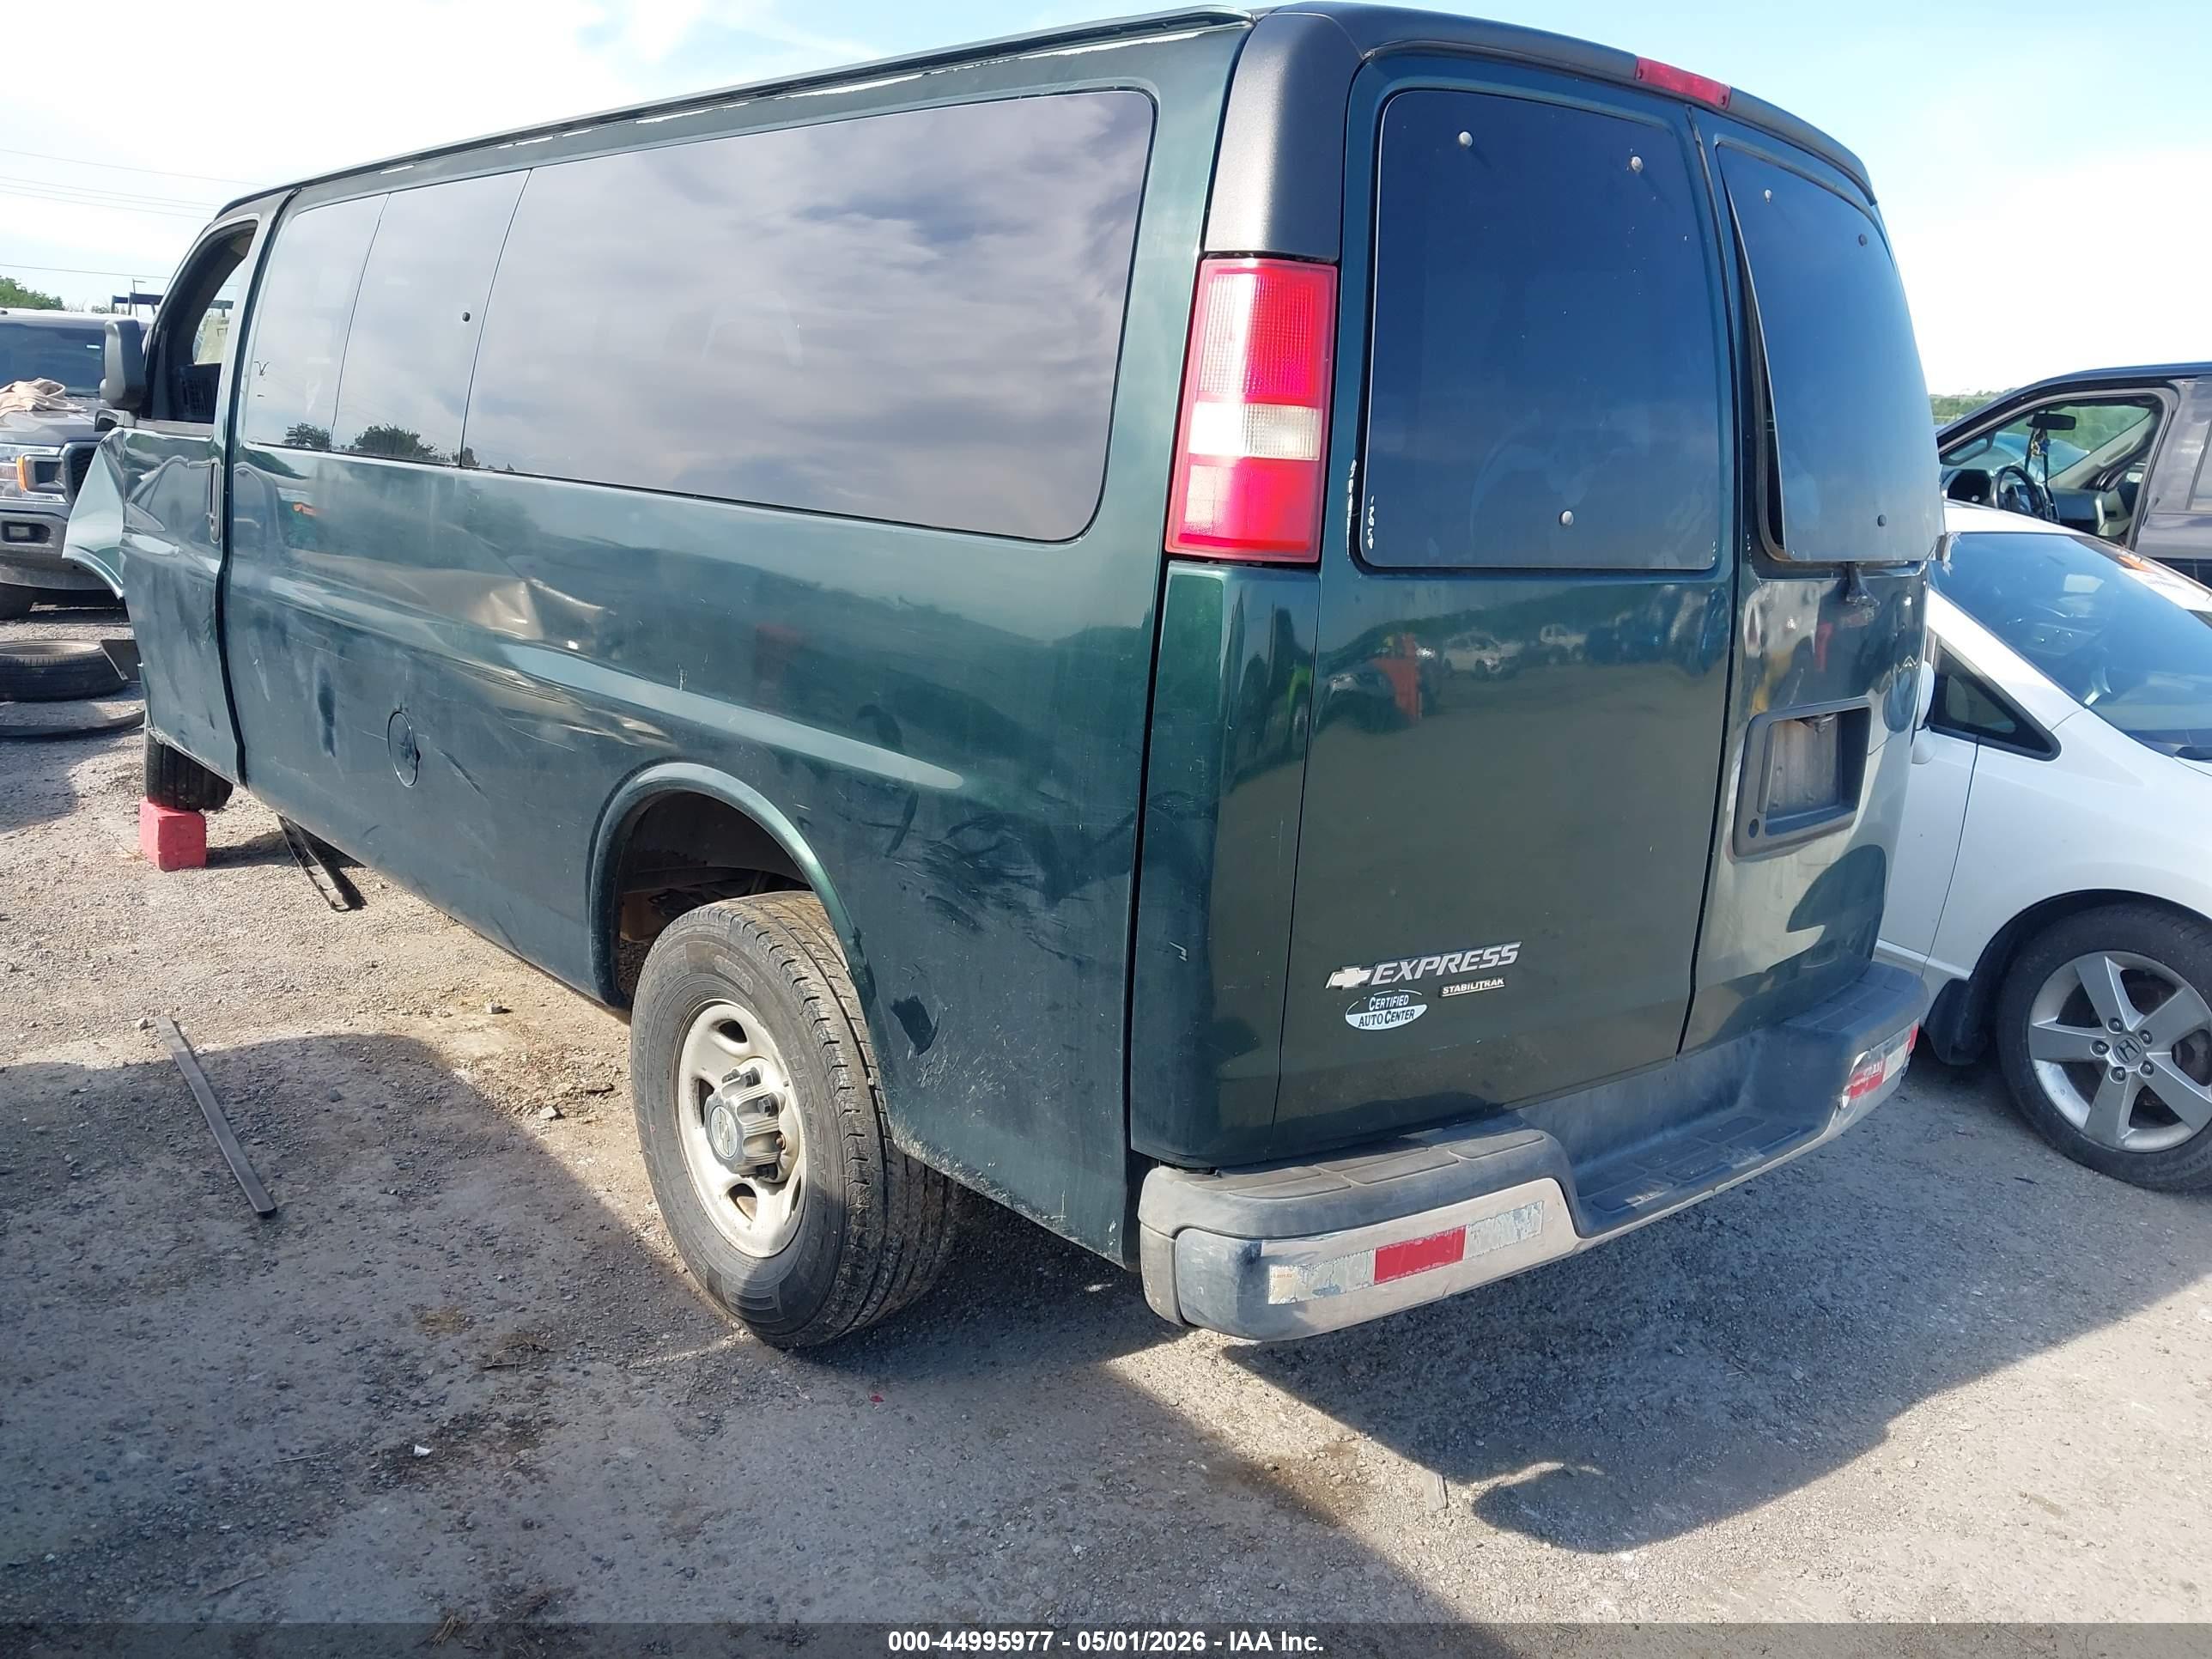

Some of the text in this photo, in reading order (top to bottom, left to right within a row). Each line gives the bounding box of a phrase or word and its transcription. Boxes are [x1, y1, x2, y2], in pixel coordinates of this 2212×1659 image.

[1371, 942, 1522, 985] EXPRESS
[1442, 978, 1504, 994] STABILITRAK
[1369, 994, 1409, 1012] CERTIFIED
[1358, 1008, 1415, 1027] AUTO CENTER
